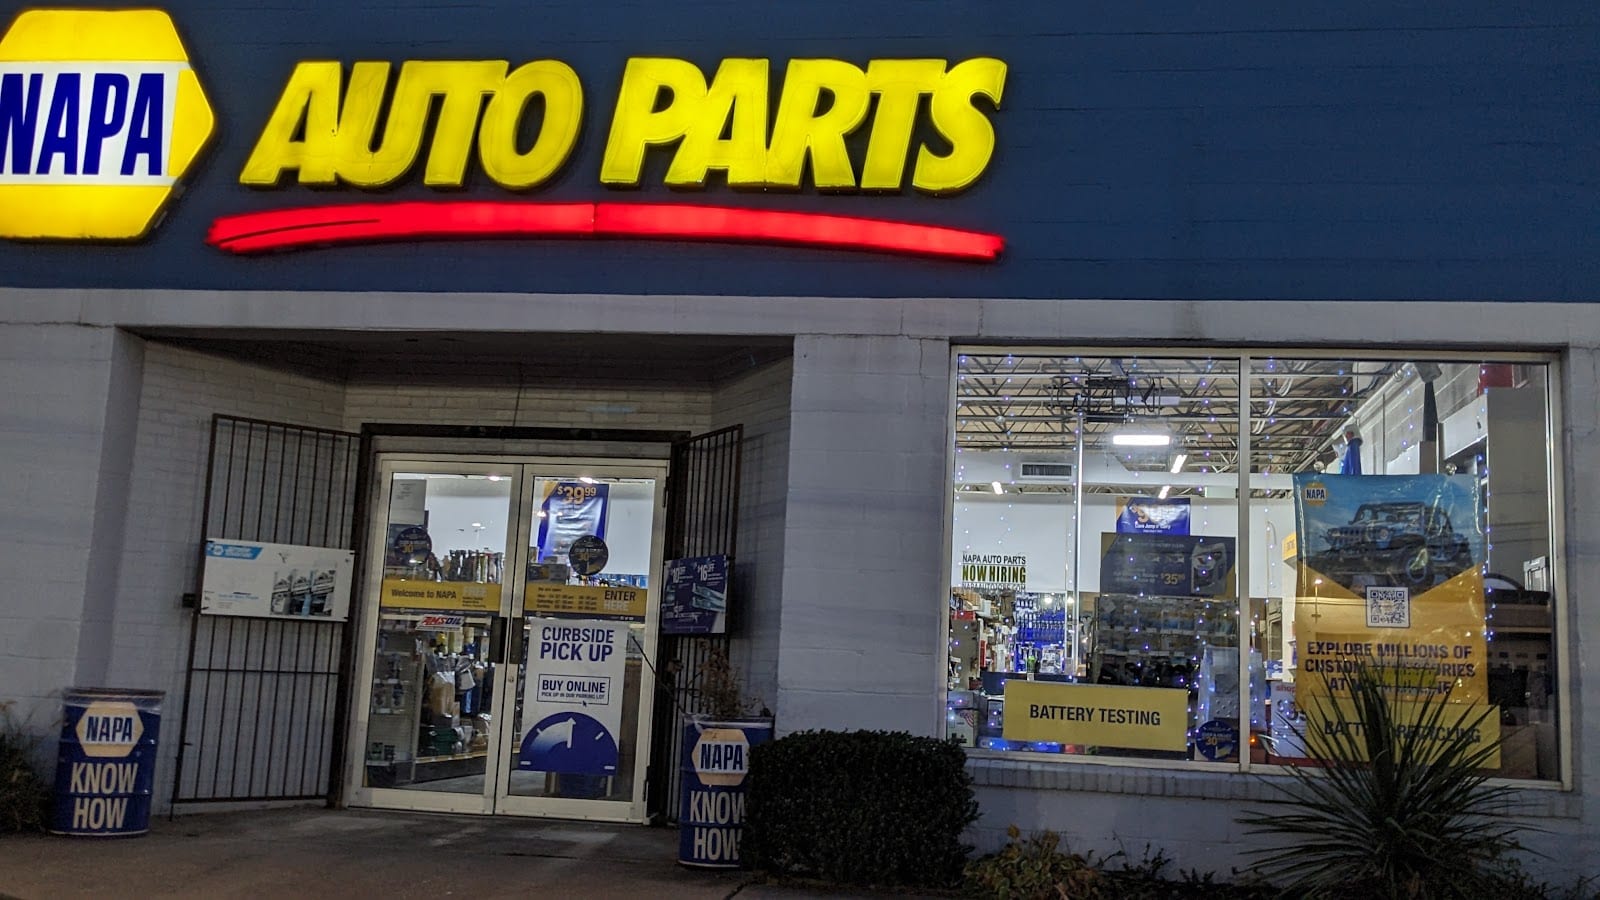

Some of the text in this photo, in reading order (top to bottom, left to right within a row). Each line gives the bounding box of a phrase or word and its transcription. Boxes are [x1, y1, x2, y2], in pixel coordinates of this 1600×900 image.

[0, 56, 1008, 191] NAPA AUTO PARTS
[1306, 489, 1325, 499] NAPA
[962, 554, 1026, 565] NAPA AUTO PARTS
[962, 565, 1026, 583] NOW HIRING
[391, 589, 457, 599] Welcome to NAPA
[605, 590, 636, 601] ENTER
[604, 601, 629, 611] HERE
[421, 616, 462, 626] AMSOIL
[542, 626, 615, 644] CURBSIDE
[540, 642, 613, 662] PICK UP
[1307, 641, 1473, 660] EXPLORE MILLIONS OF
[1305, 659, 1365, 674] CUSTOM
[542, 679, 606, 693] BUY ONLINE
[1328, 678, 1345, 692] AT
[1030, 704, 1161, 726] BATTERY TESTING
[86, 716, 133, 742] NAPA
[1205, 736, 1217, 746] 30
[701, 743, 744, 770] NAPA
[70, 762, 139, 795] KNOW
[72, 797, 129, 829] HOW
[690, 790, 746, 825] KNOW
[693, 828, 743, 861] HOW
